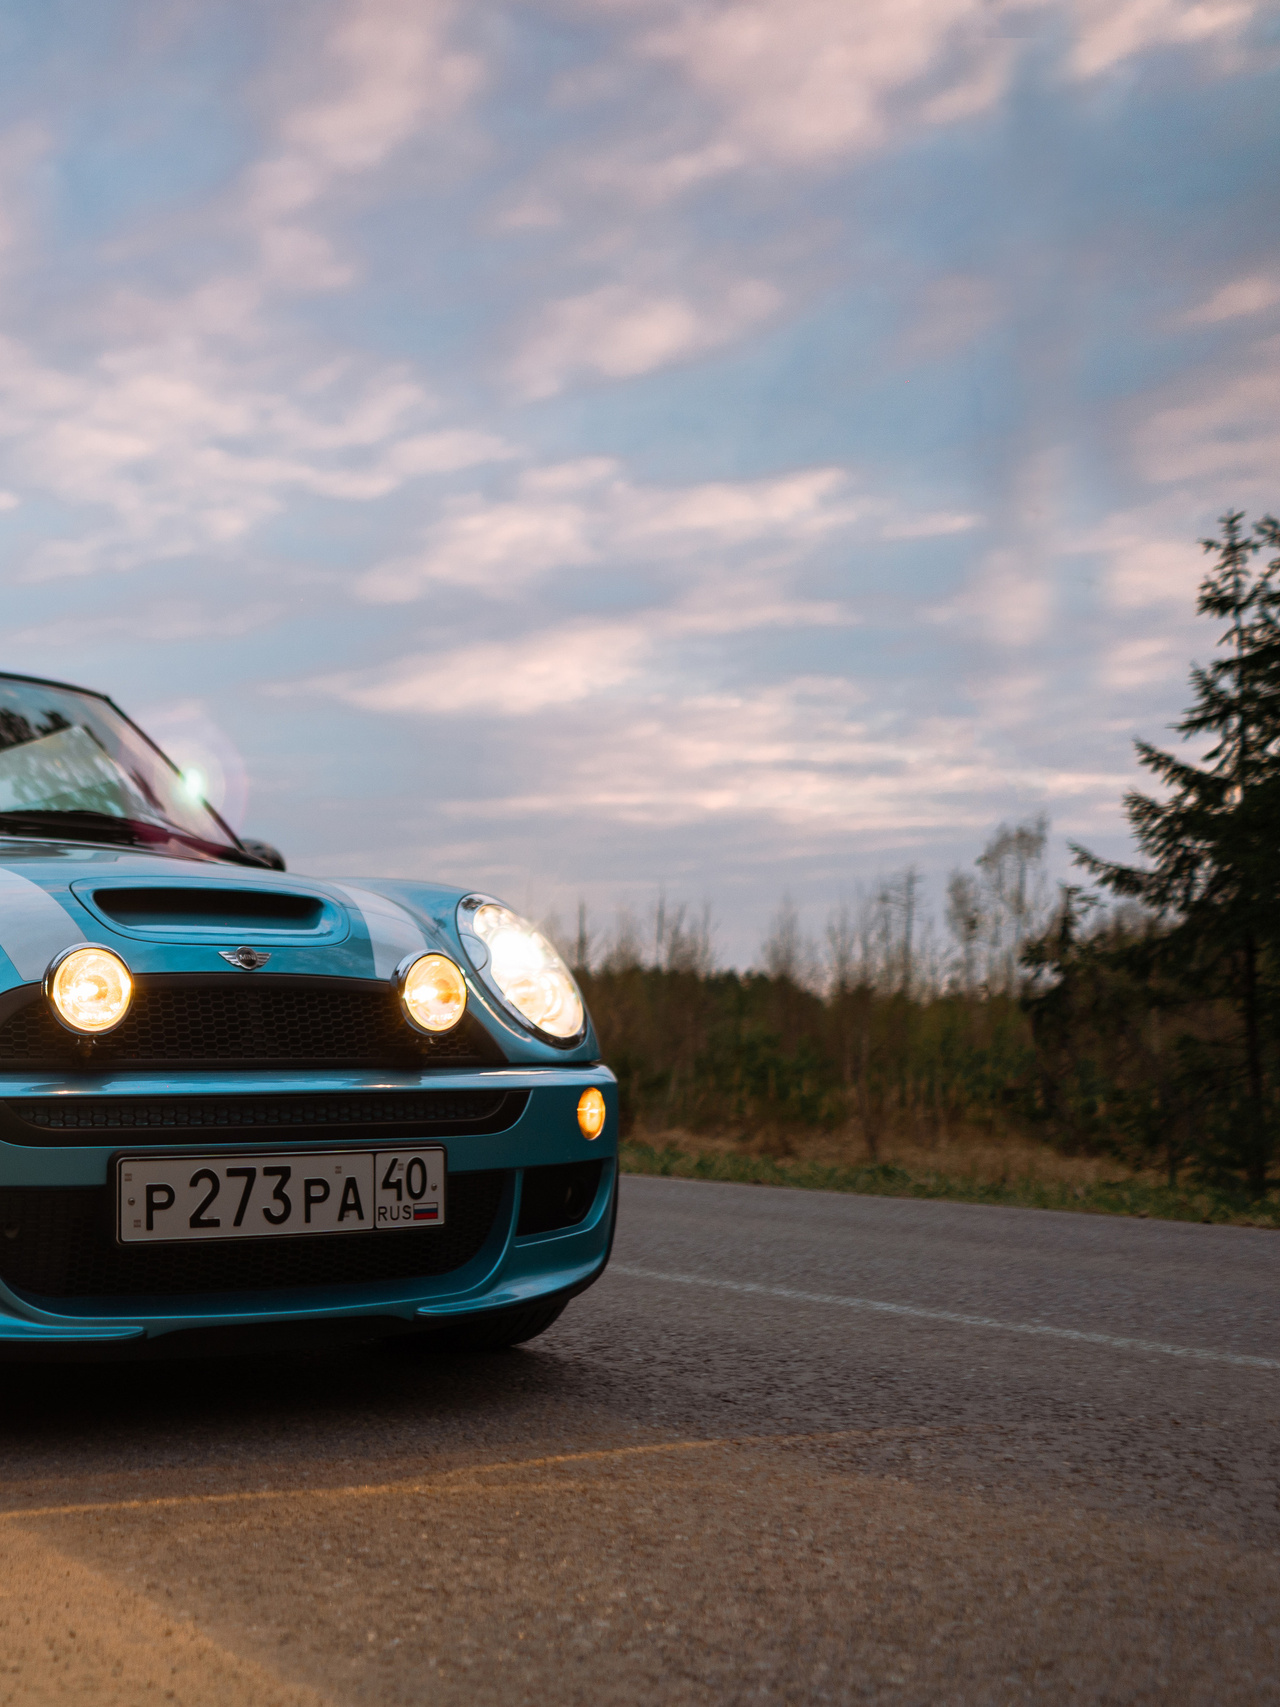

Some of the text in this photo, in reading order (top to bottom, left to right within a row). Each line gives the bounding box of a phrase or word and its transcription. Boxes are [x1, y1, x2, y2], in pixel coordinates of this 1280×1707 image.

[239, 953, 257, 961] MINI
[381, 1156, 428, 1202] 40
[377, 1204, 413, 1222] RUS
